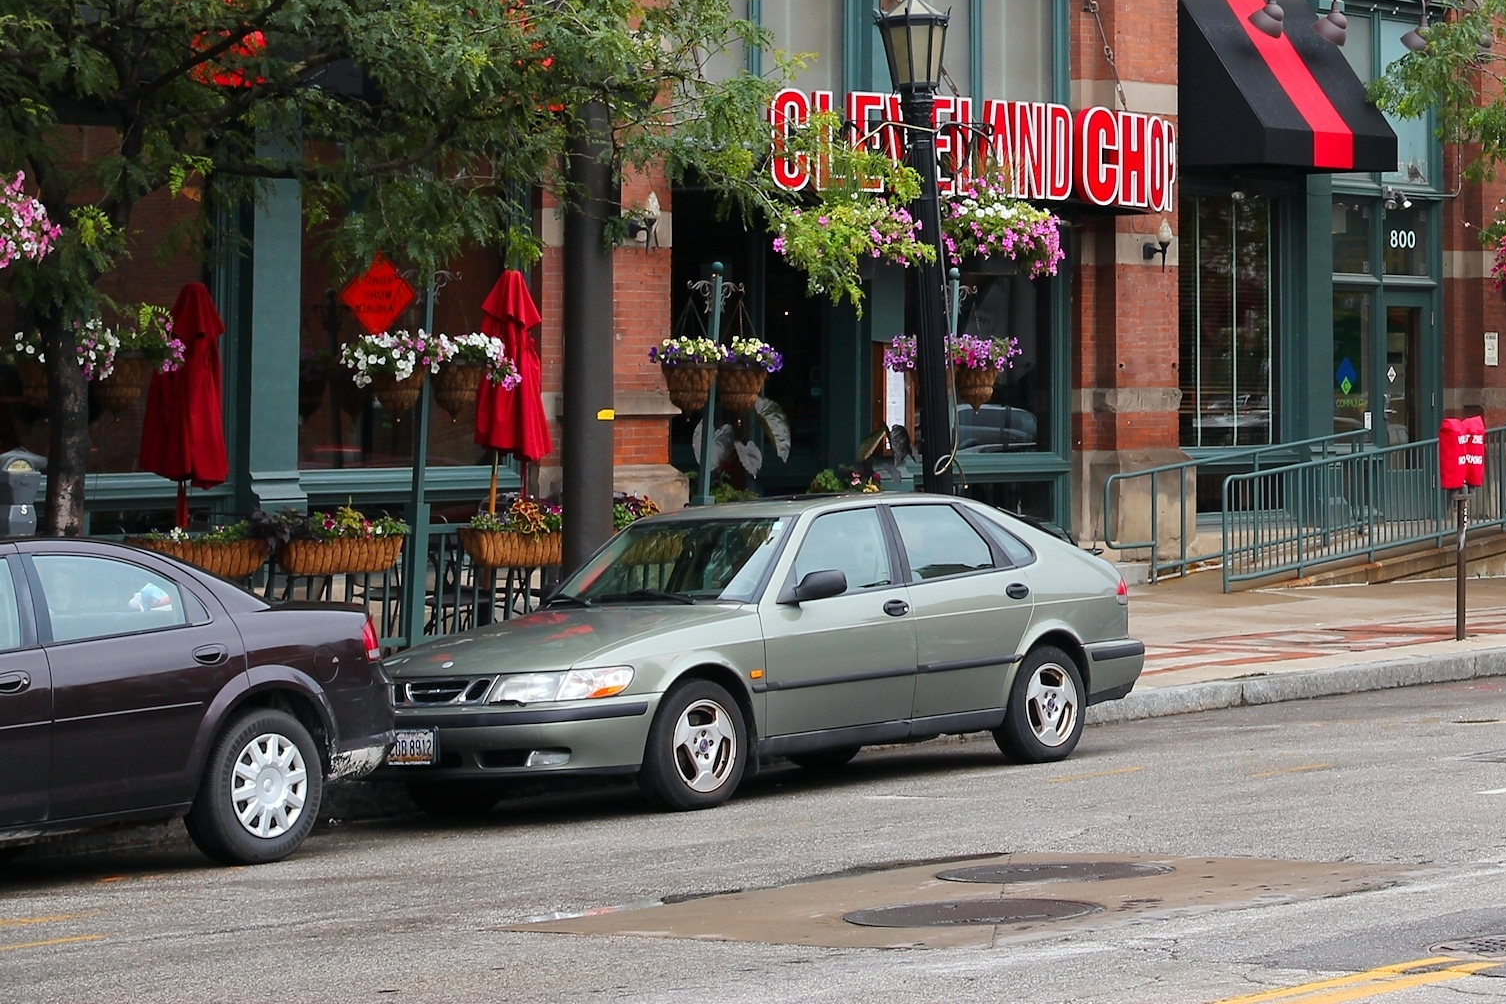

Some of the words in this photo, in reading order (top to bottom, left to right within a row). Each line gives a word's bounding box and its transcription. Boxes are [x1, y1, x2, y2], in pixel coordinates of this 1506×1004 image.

[1077, 107, 1176, 213] CHOP
[1390, 229, 1417, 249] 800
[20, 503, 28, 515] S
